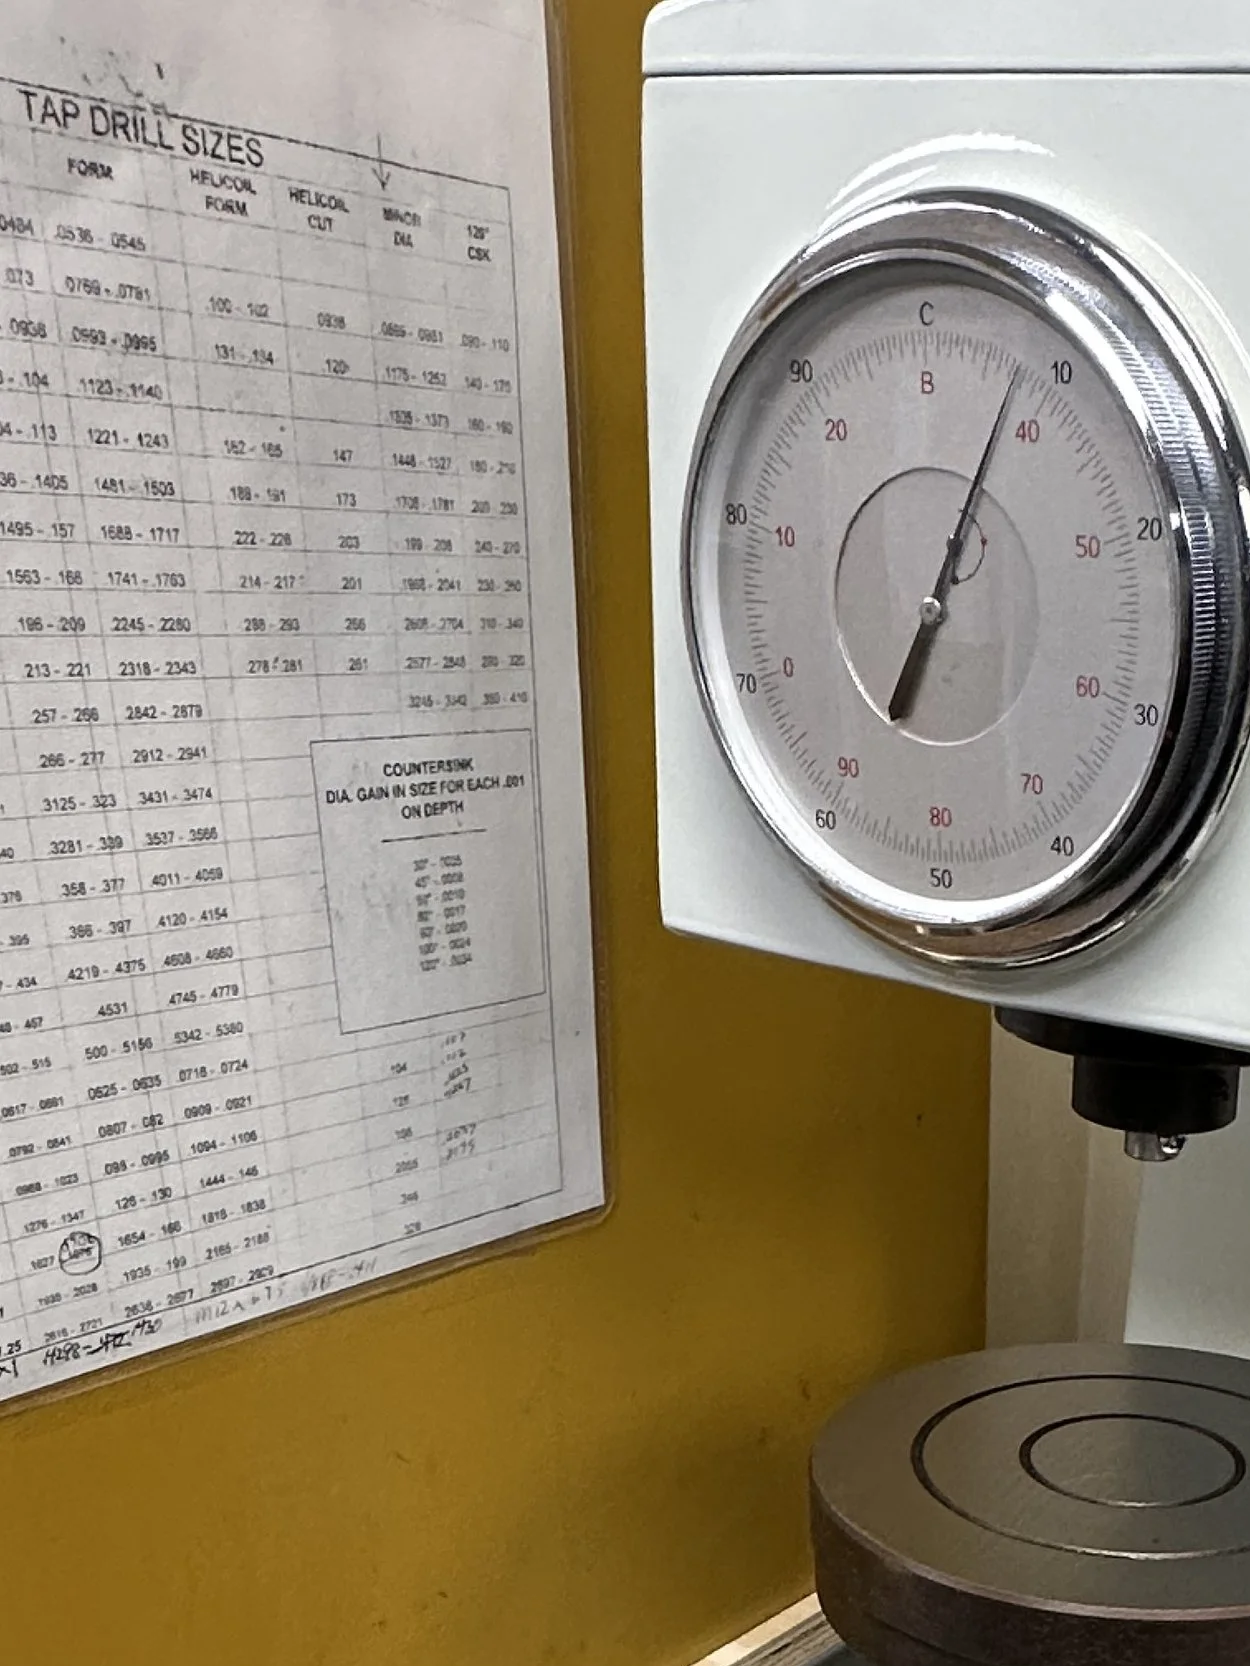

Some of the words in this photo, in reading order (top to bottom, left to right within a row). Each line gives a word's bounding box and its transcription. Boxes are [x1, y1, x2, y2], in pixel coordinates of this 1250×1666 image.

[17, 88, 80, 129] TAP
[90, 105, 174, 151] DRILL
[181, 123, 264, 168] SIZES
[67, 157, 114, 180] FORM
[190, 168, 257, 195] HELICOIL
[205, 195, 249, 217] FORM
[288, 187, 350, 213] HELICOIL
[308, 214, 334, 233] CUT
[919, 303, 934, 327] C
[789, 359, 813, 385] 90
[1050, 361, 1073, 385] 10
[920, 372, 934, 396] B
[824, 419, 848, 442] 20
[1015, 420, 1040, 443] 40
[725, 503, 748, 526] 80
[774, 527, 795, 548] 10
[1137, 517, 1162, 542] 20
[1075, 535, 1100, 559] 50
[782, 656, 794, 679] 0
[735, 672, 758, 695] 70
[1076, 675, 1100, 699] 60
[1133, 705, 1159, 729] 30
[383, 757, 474, 777] COUNTERSINK
[837, 756, 859, 779] 90
[326, 789, 353, 804] DIA.
[357, 785, 389, 801] GAIN
[393, 783, 406, 798] IN
[409, 781, 437, 797] SIZE
[440, 778, 464, 793] FOR
[467, 776, 500, 791] EACH
[1020, 773, 1043, 796] 70
[401, 804, 421, 820] ON
[424, 800, 464, 817] DEPTH
[815, 809, 837, 832] 60
[928, 806, 952, 829] 80
[1050, 835, 1074, 859] 40
[929, 867, 953, 890] 50
